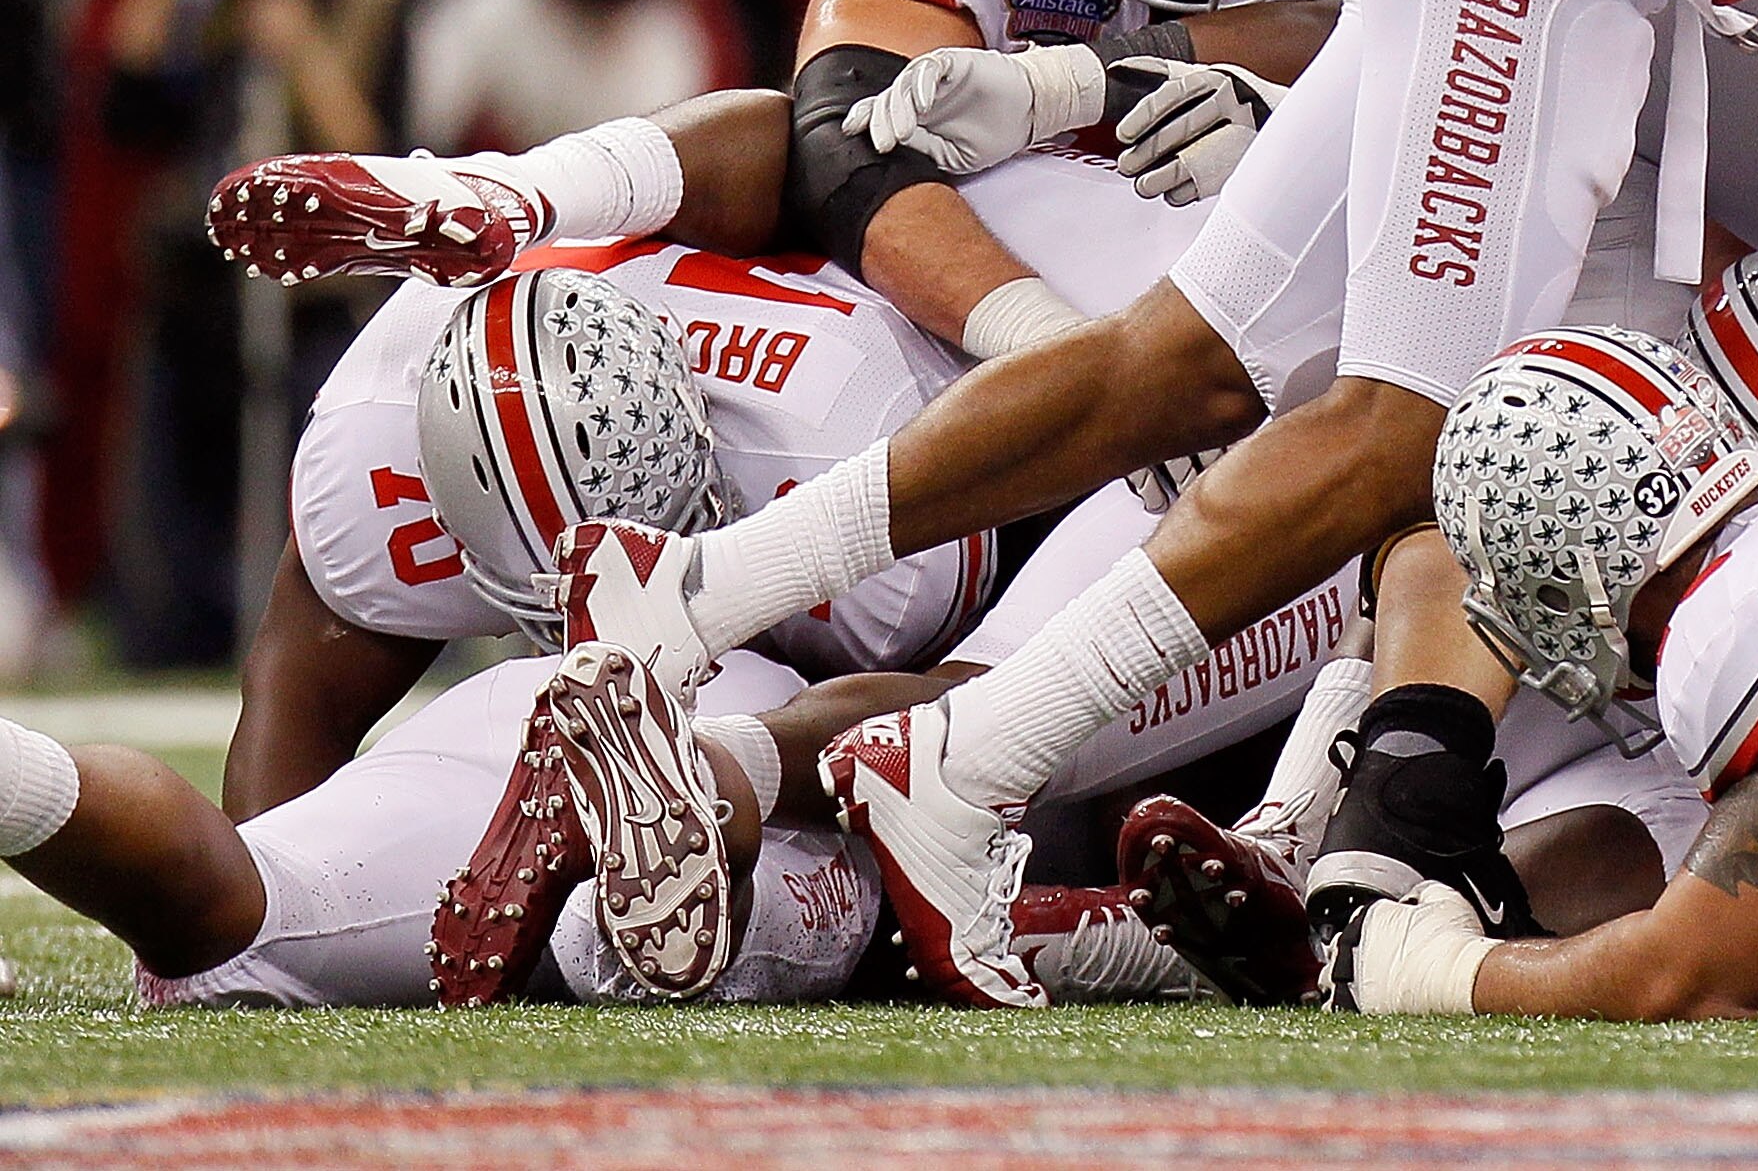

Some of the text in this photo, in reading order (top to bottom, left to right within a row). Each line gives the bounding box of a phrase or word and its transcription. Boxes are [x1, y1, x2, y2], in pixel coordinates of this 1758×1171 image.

[1012, 10, 1060, 35] SUGAR
[1638, 475, 1678, 516] 32
[1689, 457, 1751, 518] BUCKEYES
